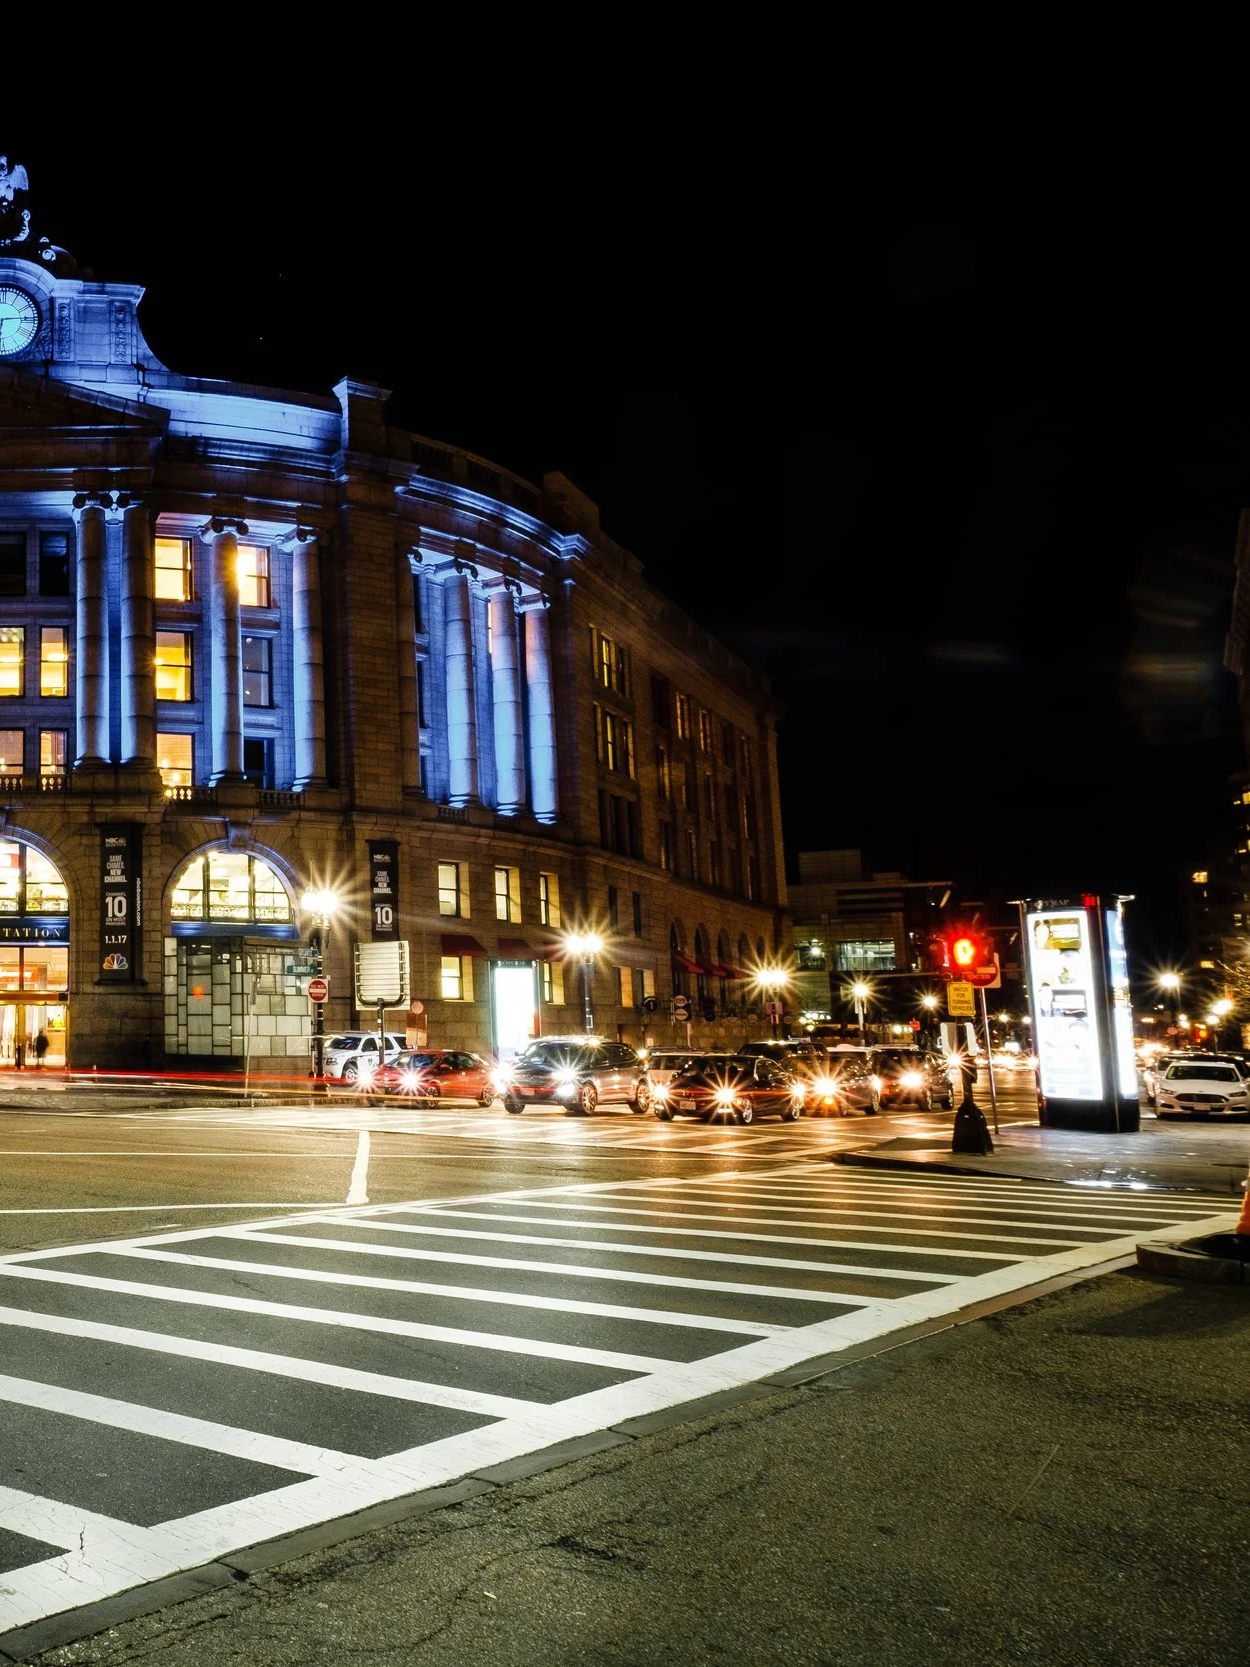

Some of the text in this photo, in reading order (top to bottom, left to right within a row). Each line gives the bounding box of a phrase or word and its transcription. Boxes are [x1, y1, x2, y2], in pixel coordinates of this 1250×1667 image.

[105, 896, 127, 918] 10
[374, 907, 393, 925] 10
[105, 935, 127, 944] 1.1.17
